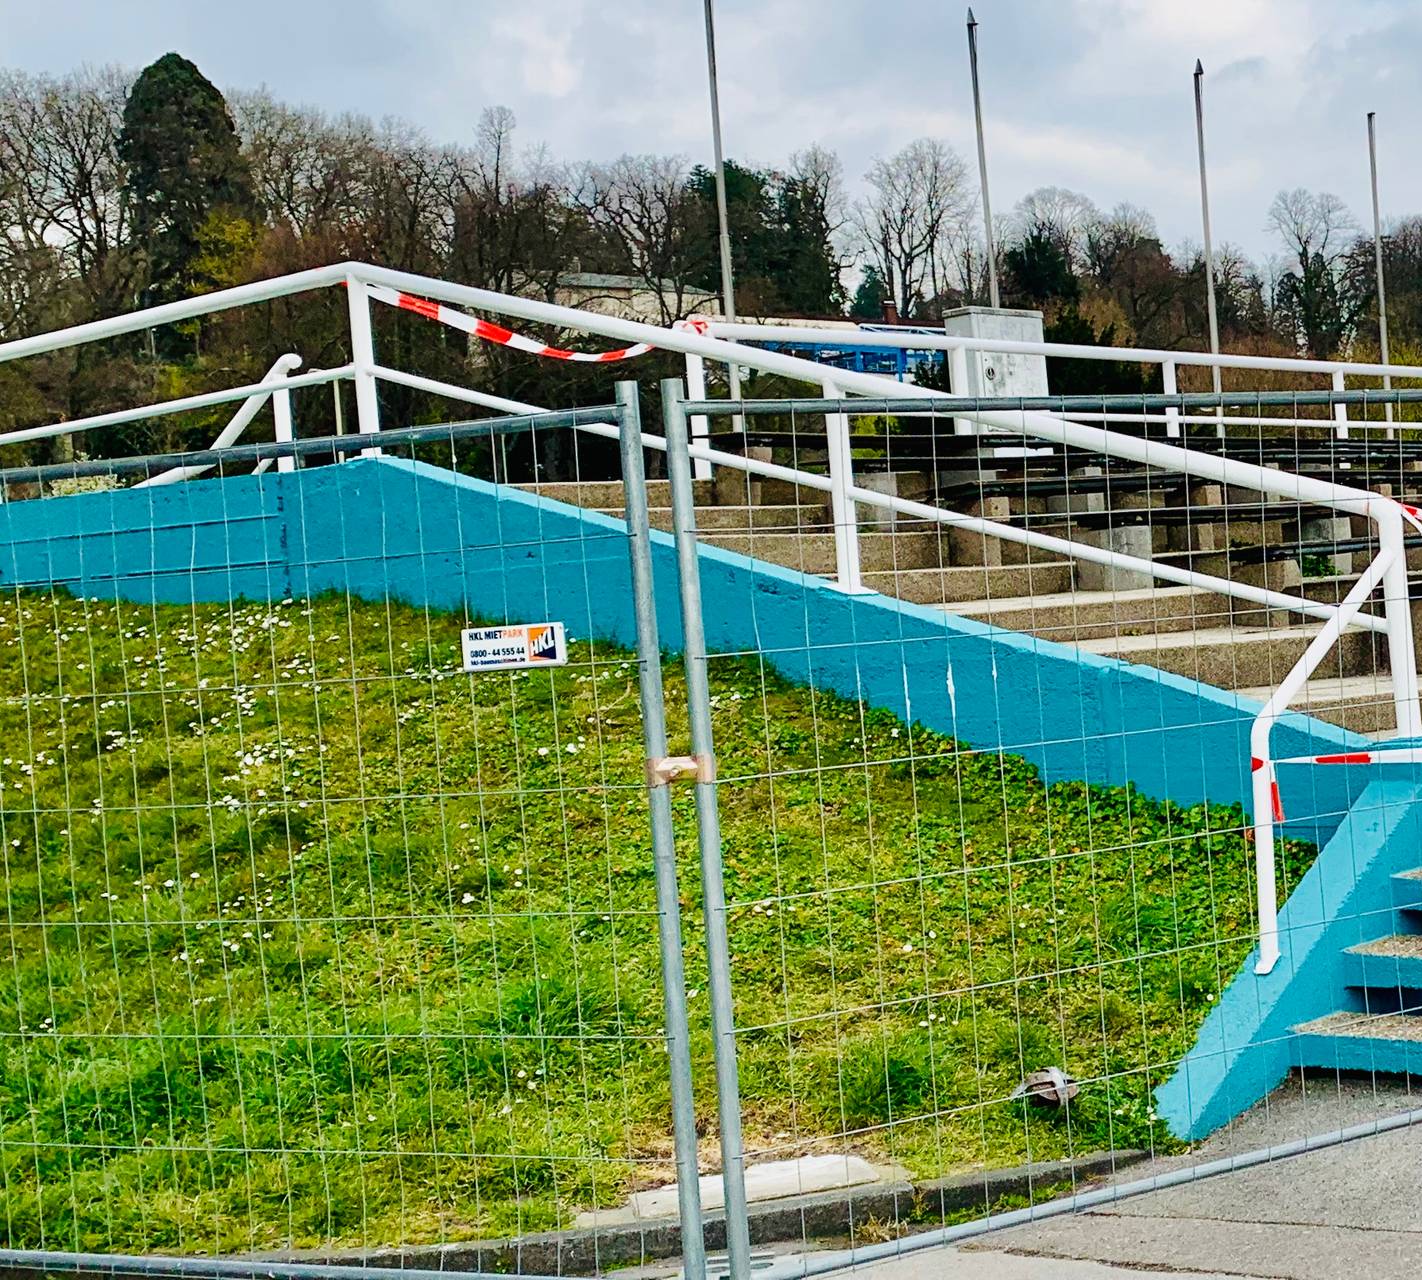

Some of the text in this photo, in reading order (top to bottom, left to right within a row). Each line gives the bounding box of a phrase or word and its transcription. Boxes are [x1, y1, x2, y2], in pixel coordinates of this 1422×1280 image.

[468, 628, 523, 641] HKL MIETPARK
[530, 627, 555, 656] HKL
[470, 650, 487, 658] 0800
[492, 648, 501, 656] 44
[501, 647, 515, 656] 555
